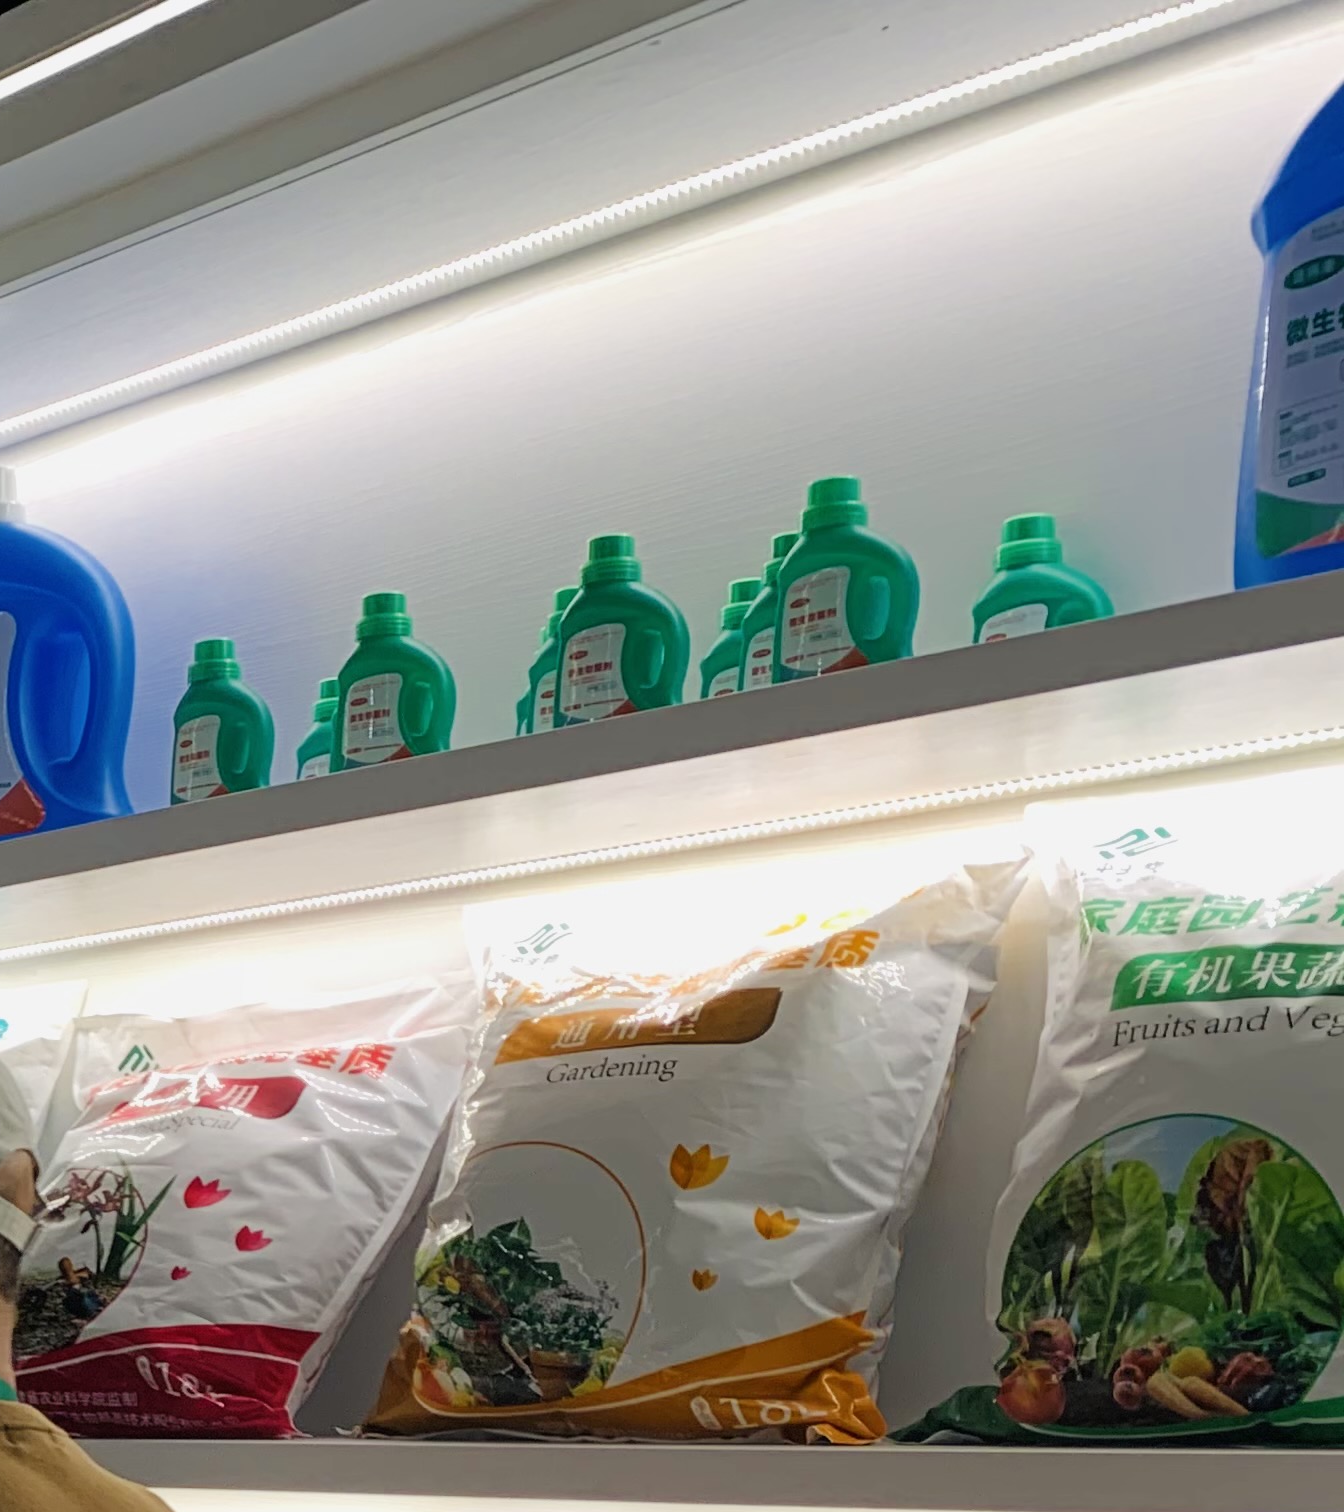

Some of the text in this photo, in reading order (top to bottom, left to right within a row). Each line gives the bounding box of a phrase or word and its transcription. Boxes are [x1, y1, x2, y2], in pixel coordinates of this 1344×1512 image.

[1286, 306, 1344, 348] 微生
[1114, 1014, 1195, 1047] Fruits
[1204, 1007, 1269, 1036] and
[546, 1053, 678, 1084] Gardening
